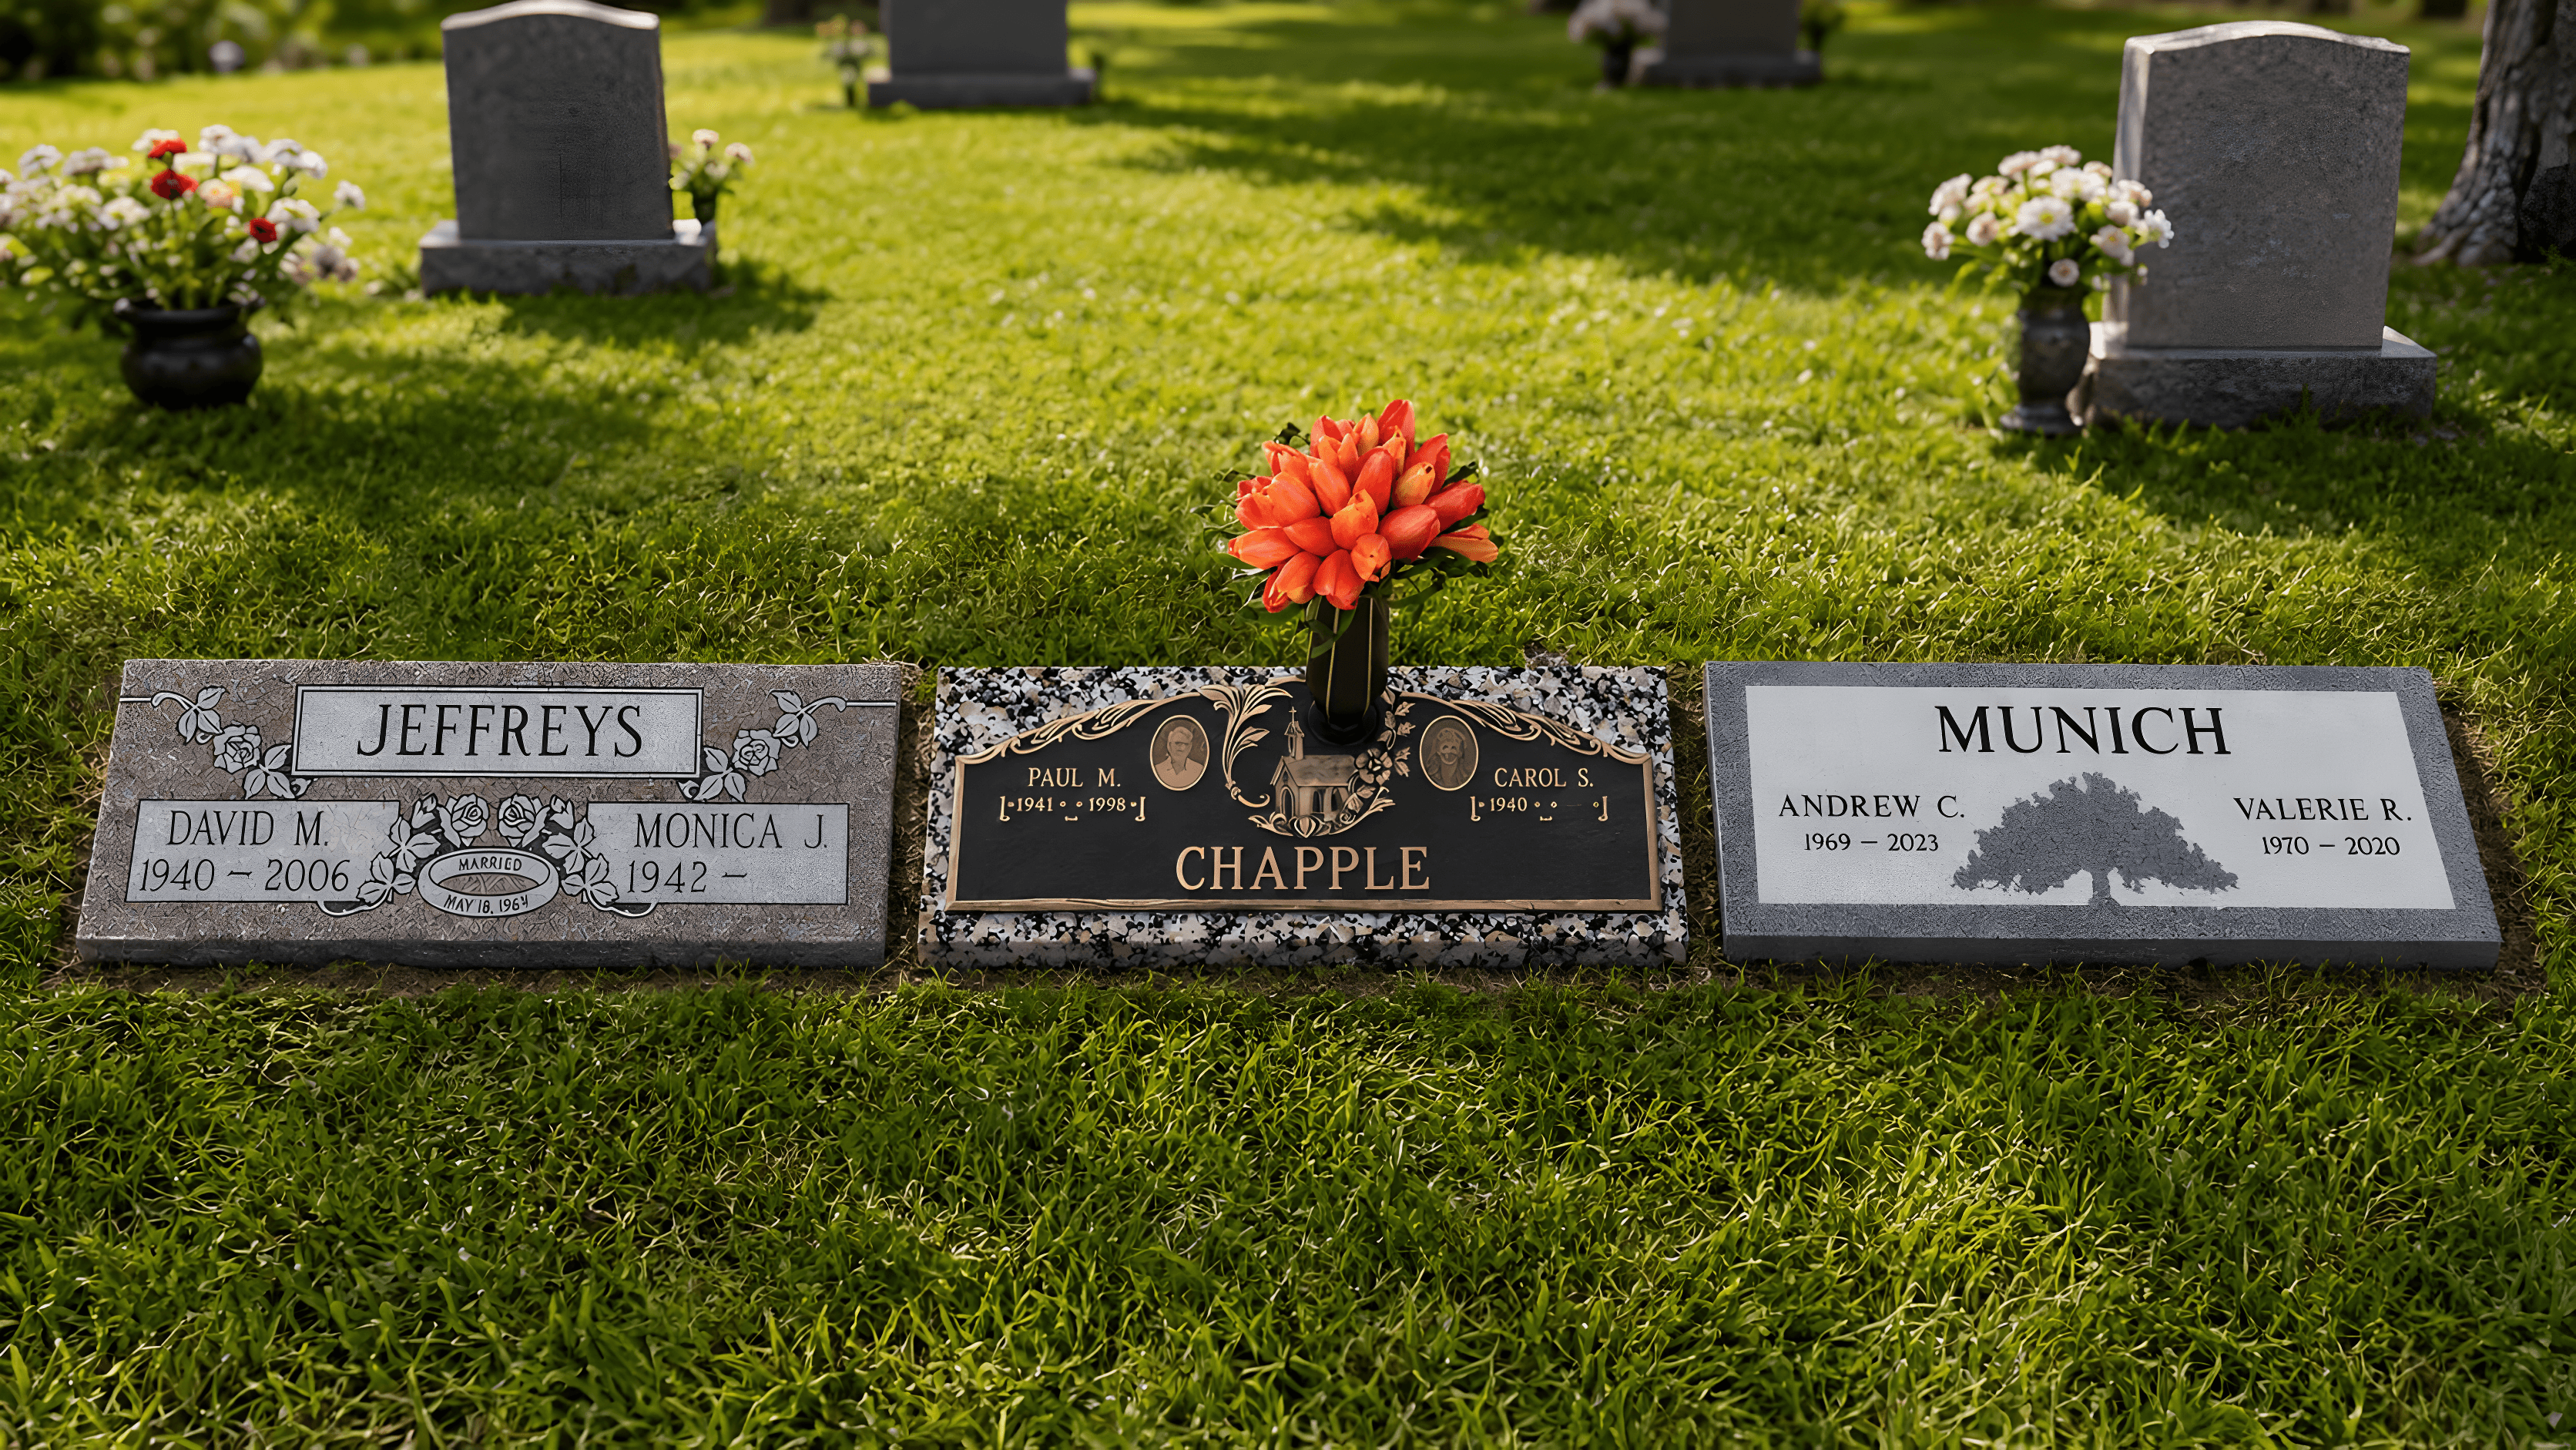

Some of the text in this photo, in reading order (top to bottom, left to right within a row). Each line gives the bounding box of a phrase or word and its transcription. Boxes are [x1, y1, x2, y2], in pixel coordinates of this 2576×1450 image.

[357, 703, 642, 757] JEFFREYS
[1934, 705, 2231, 755] MUNICH
[1028, 767, 1121, 787] PAUL M.
[1494, 767, 1594, 787] CAROL S.
[1779, 794, 1965, 818] ANDREW C.
[2234, 797, 2412, 821] VALERIE R.
[166, 810, 329, 846] DAVID M.
[634, 813, 827, 849] MONICA J.
[1805, 833, 1851, 851] 1969
[1887, 833, 1939, 851] 2023
[2262, 836, 2309, 855] 1970
[2344, 836, 2400, 855] 2020
[139, 858, 215, 892] 1940
[264, 858, 350, 891] 2006
[627, 861, 708, 892] 1942
[1176, 846, 1430, 891] CHAPPLE
